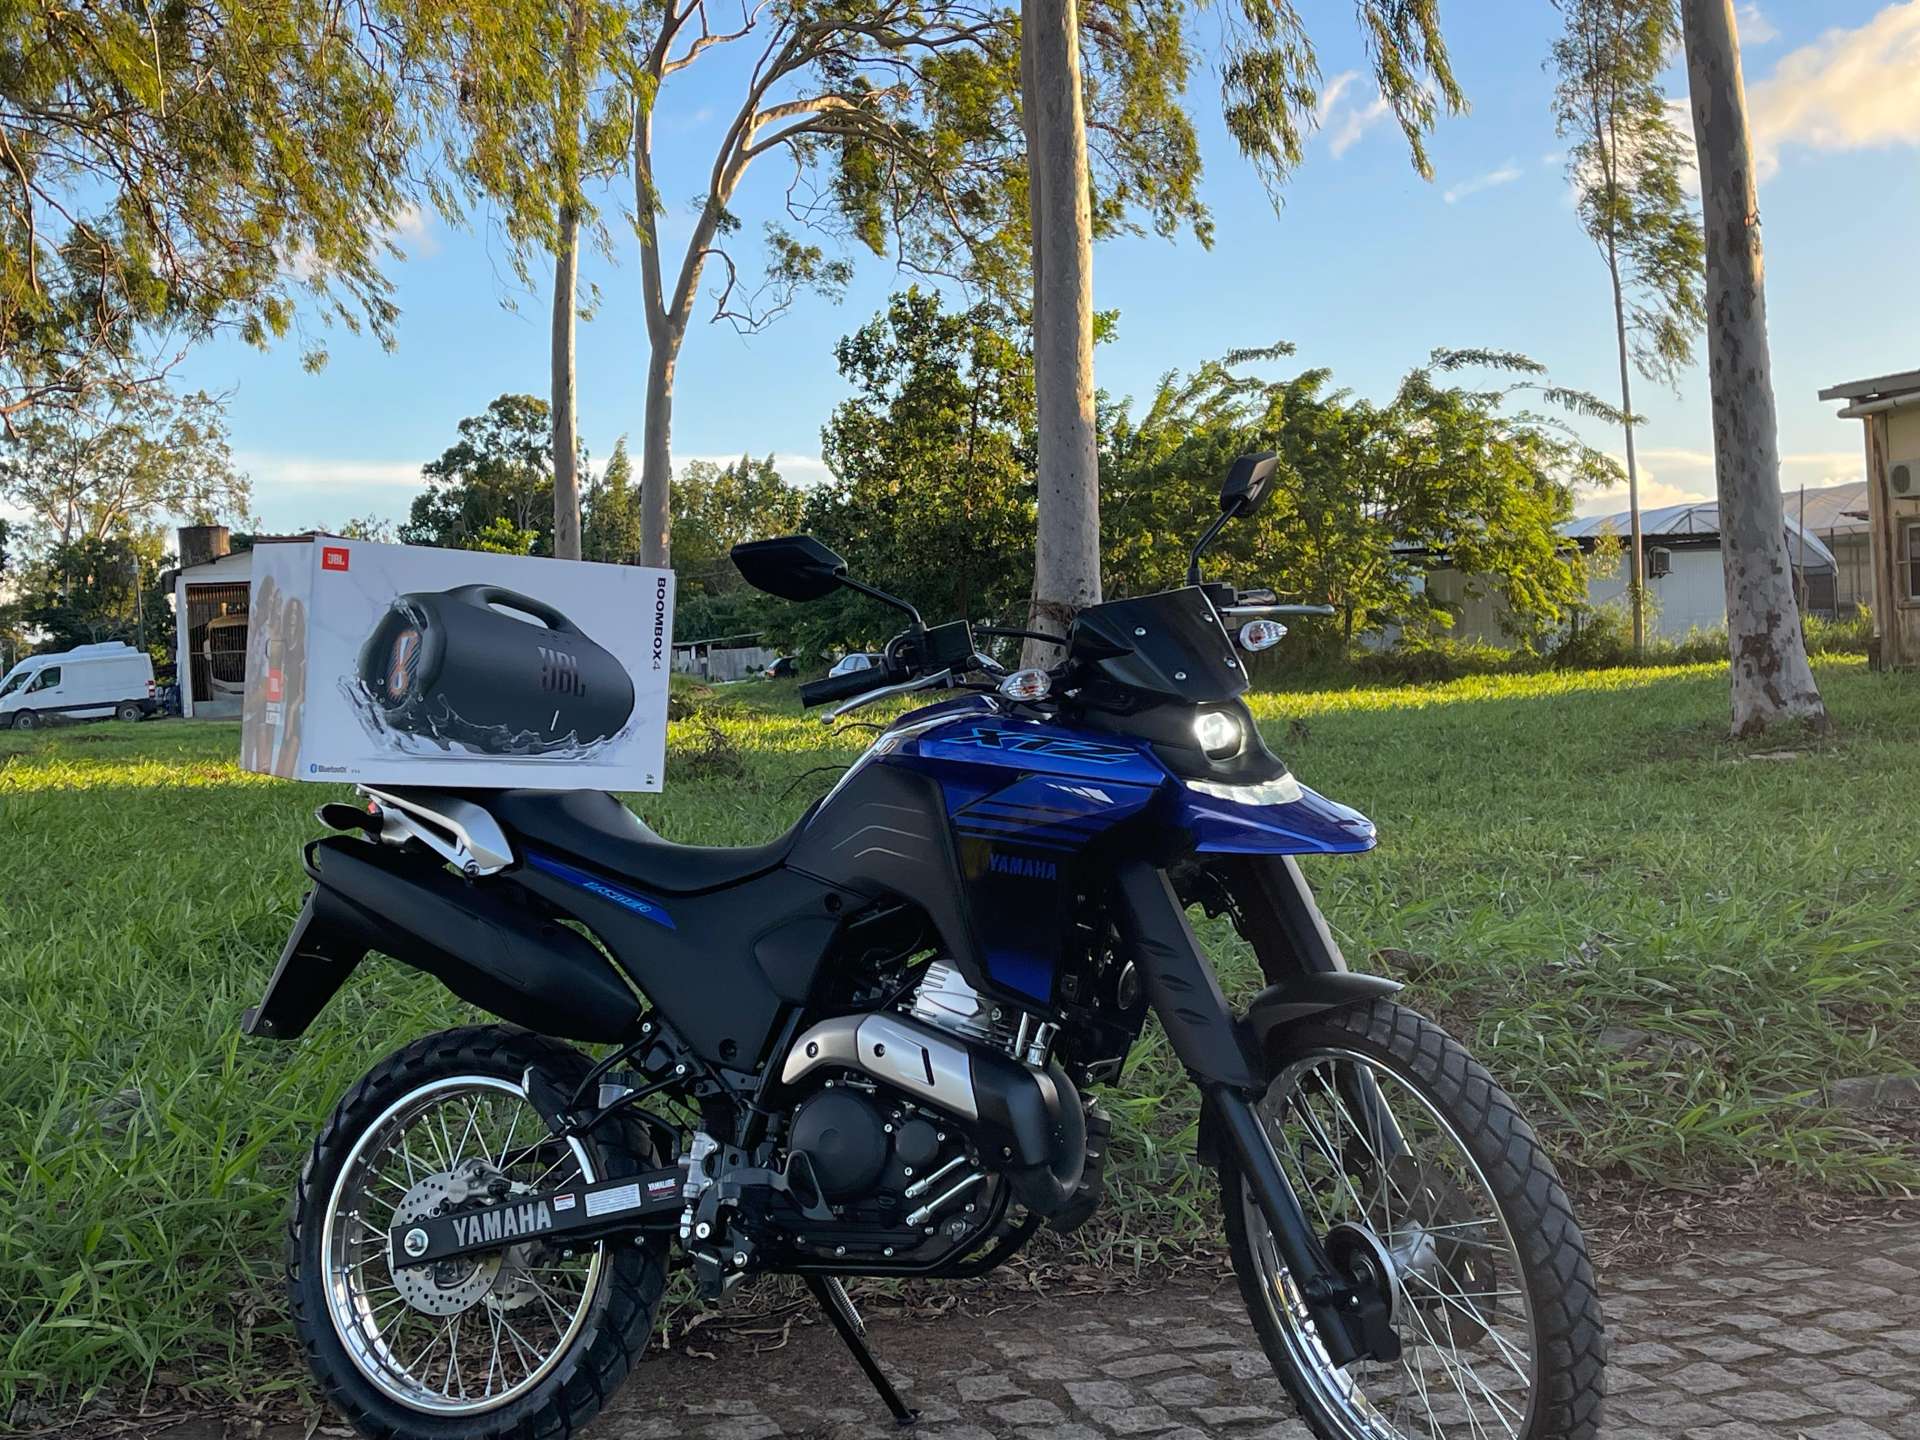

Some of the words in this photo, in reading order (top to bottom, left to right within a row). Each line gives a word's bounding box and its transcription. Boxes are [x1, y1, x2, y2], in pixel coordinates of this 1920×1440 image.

[328, 553, 345, 566] JBL
[538, 646, 585, 698] JBL
[940, 728, 1140, 764] XTZ
[990, 852, 1057, 881] YAMAHA
[452, 1200, 552, 1247] YAMAHA
